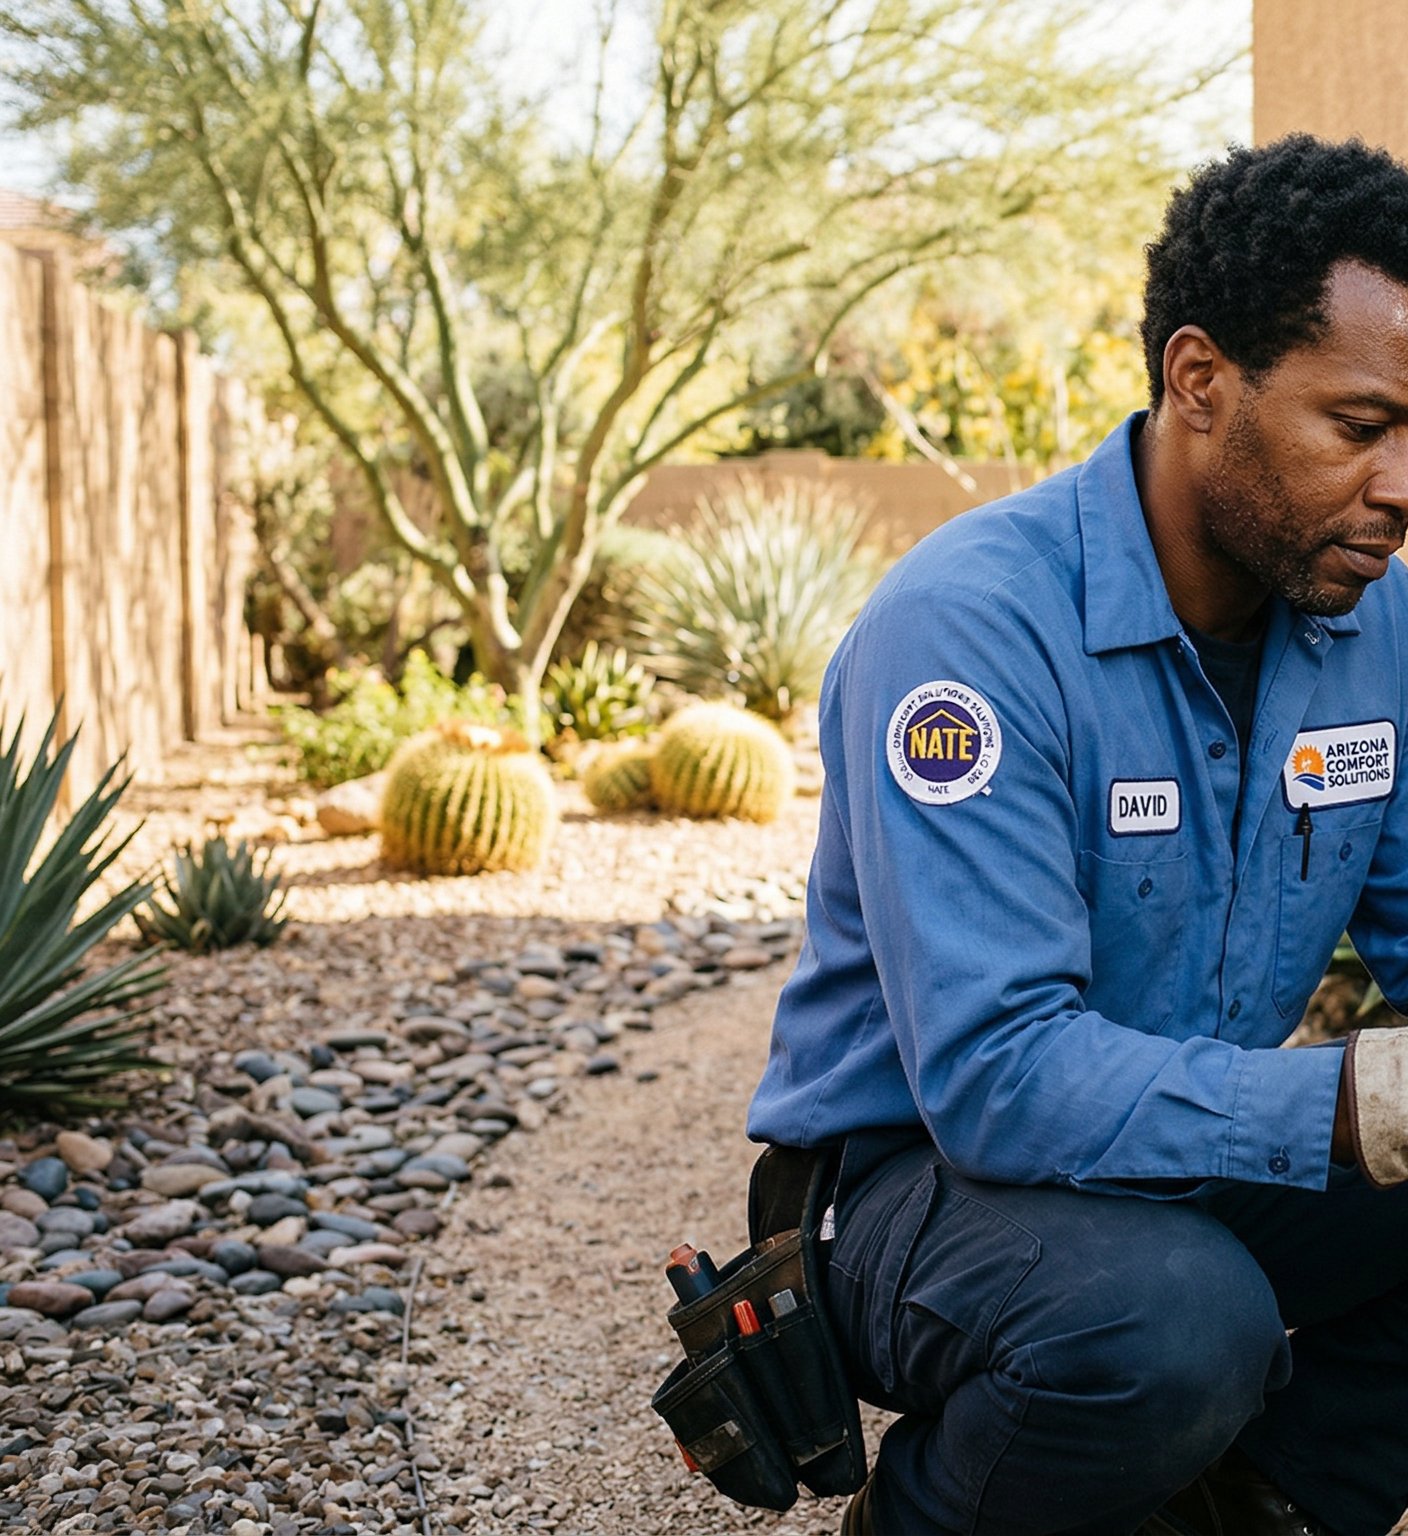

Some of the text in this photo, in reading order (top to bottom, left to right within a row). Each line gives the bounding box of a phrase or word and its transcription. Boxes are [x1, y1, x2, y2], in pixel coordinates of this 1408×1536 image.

[909, 727, 974, 760] NATE
[1326, 737, 1389, 759] ARIZONA
[1326, 752, 1390, 774] COMFORT
[1328, 767, 1391, 788] SOLUTIONS
[1119, 794, 1167, 818] DAVID
